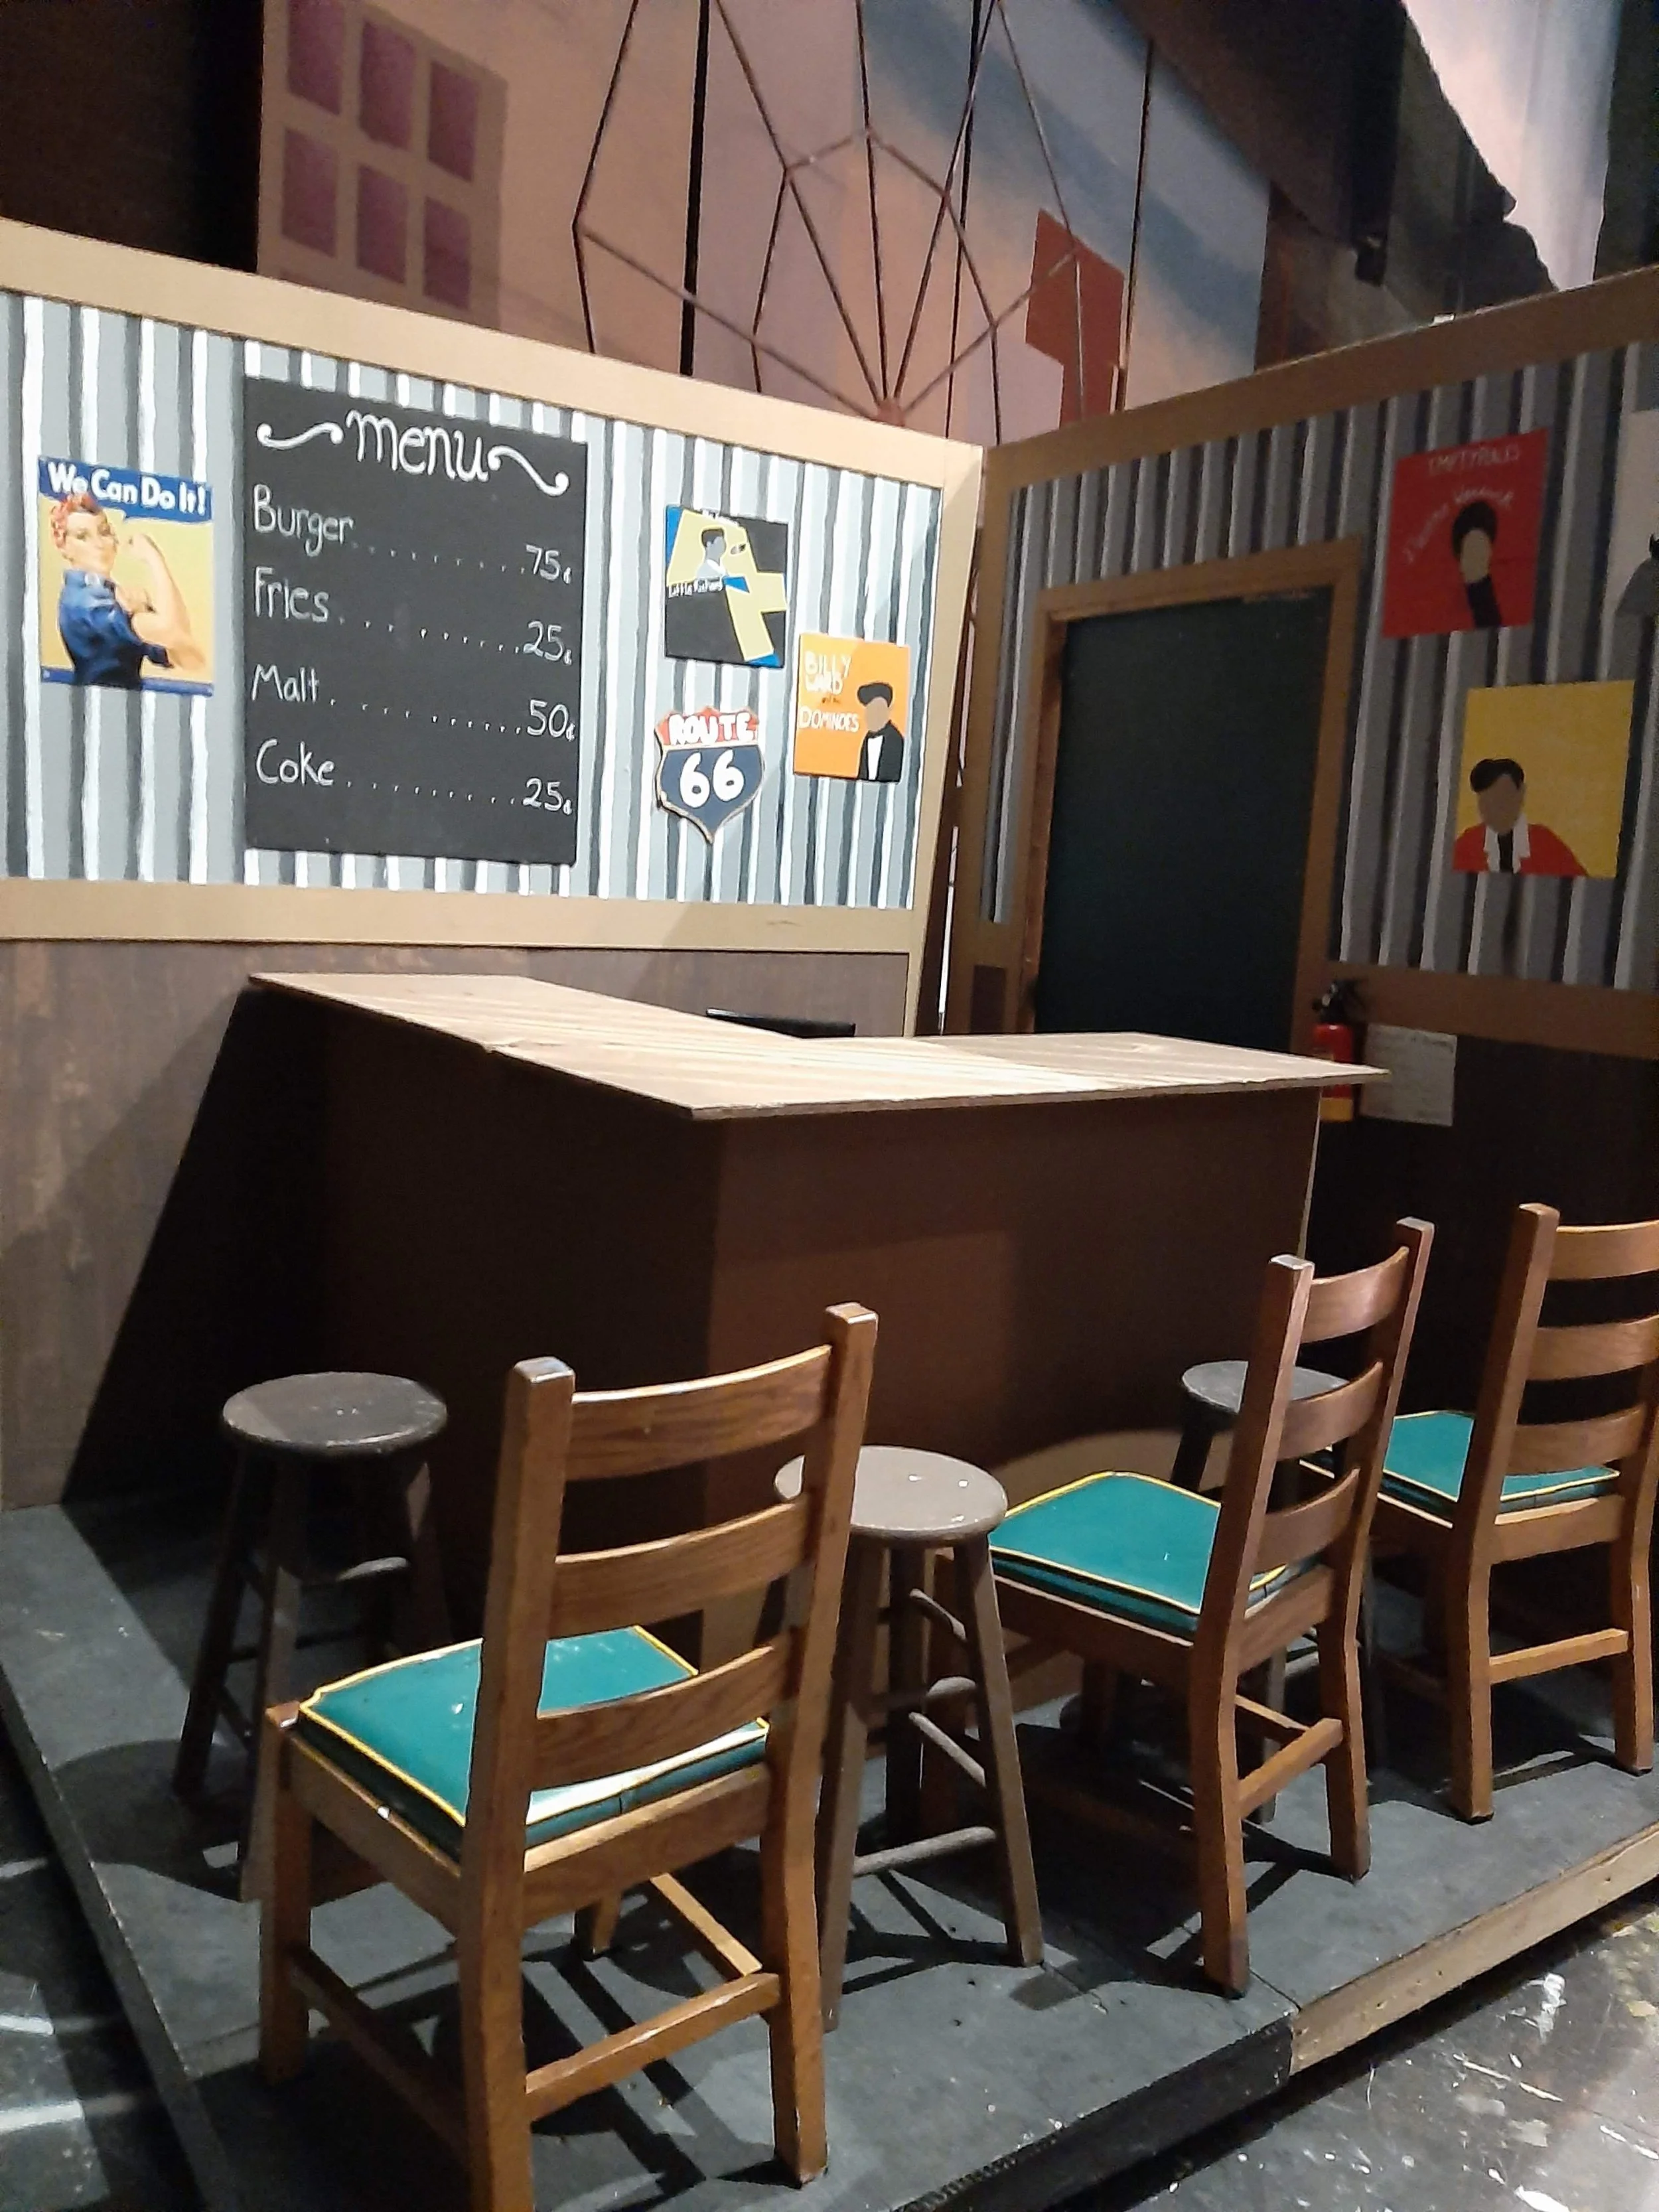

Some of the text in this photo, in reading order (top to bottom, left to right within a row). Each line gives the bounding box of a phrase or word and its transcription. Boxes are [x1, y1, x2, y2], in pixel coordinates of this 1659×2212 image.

[47, 462, 206, 516] We Can Do It!
[253, 484, 354, 557] Burger
[253, 565, 330, 623] Fries
[252, 664, 321, 703] Malt
[804, 650, 852, 680] BILLY
[666, 711, 757, 747] ROUTE
[798, 706, 860, 733] DOMINOES
[255, 738, 336, 786] Coke
[679, 749, 745, 809] 66
